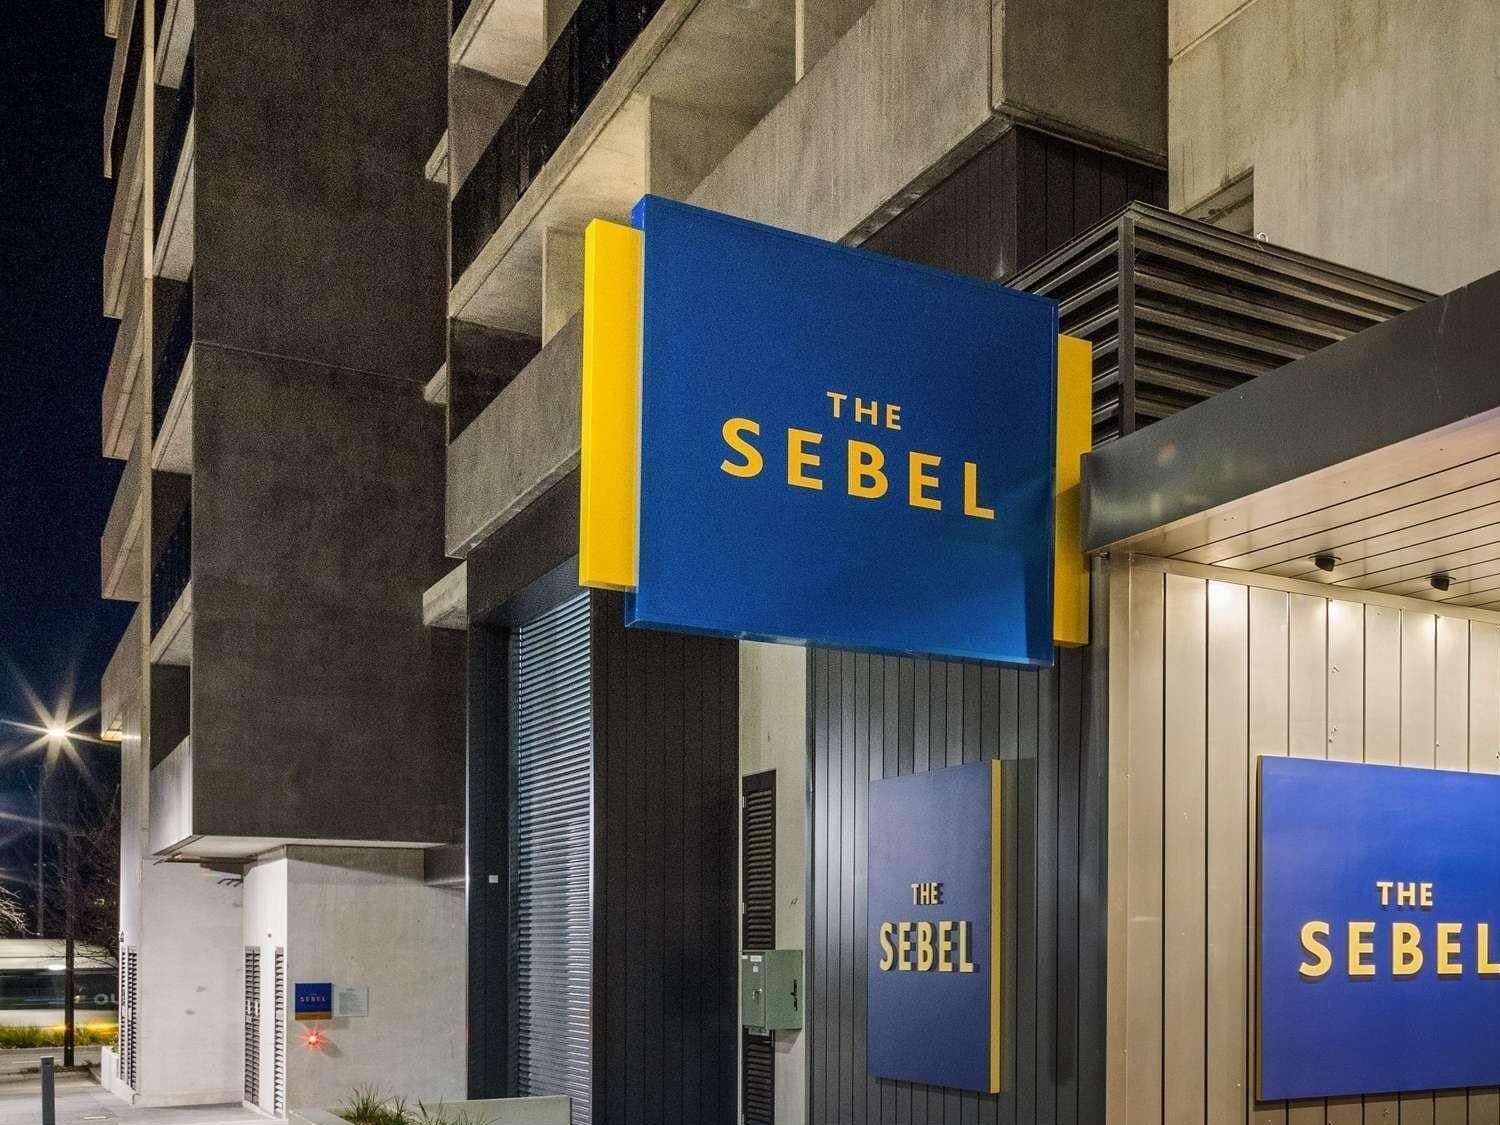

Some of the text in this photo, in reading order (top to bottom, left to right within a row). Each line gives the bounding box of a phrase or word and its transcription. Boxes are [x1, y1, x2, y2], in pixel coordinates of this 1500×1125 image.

[826, 391, 902, 430] THE
[720, 417, 995, 520] SEBEL
[911, 882, 939, 905] THE
[1376, 881, 1434, 907] THE
[879, 920, 975, 973] SEBEL
